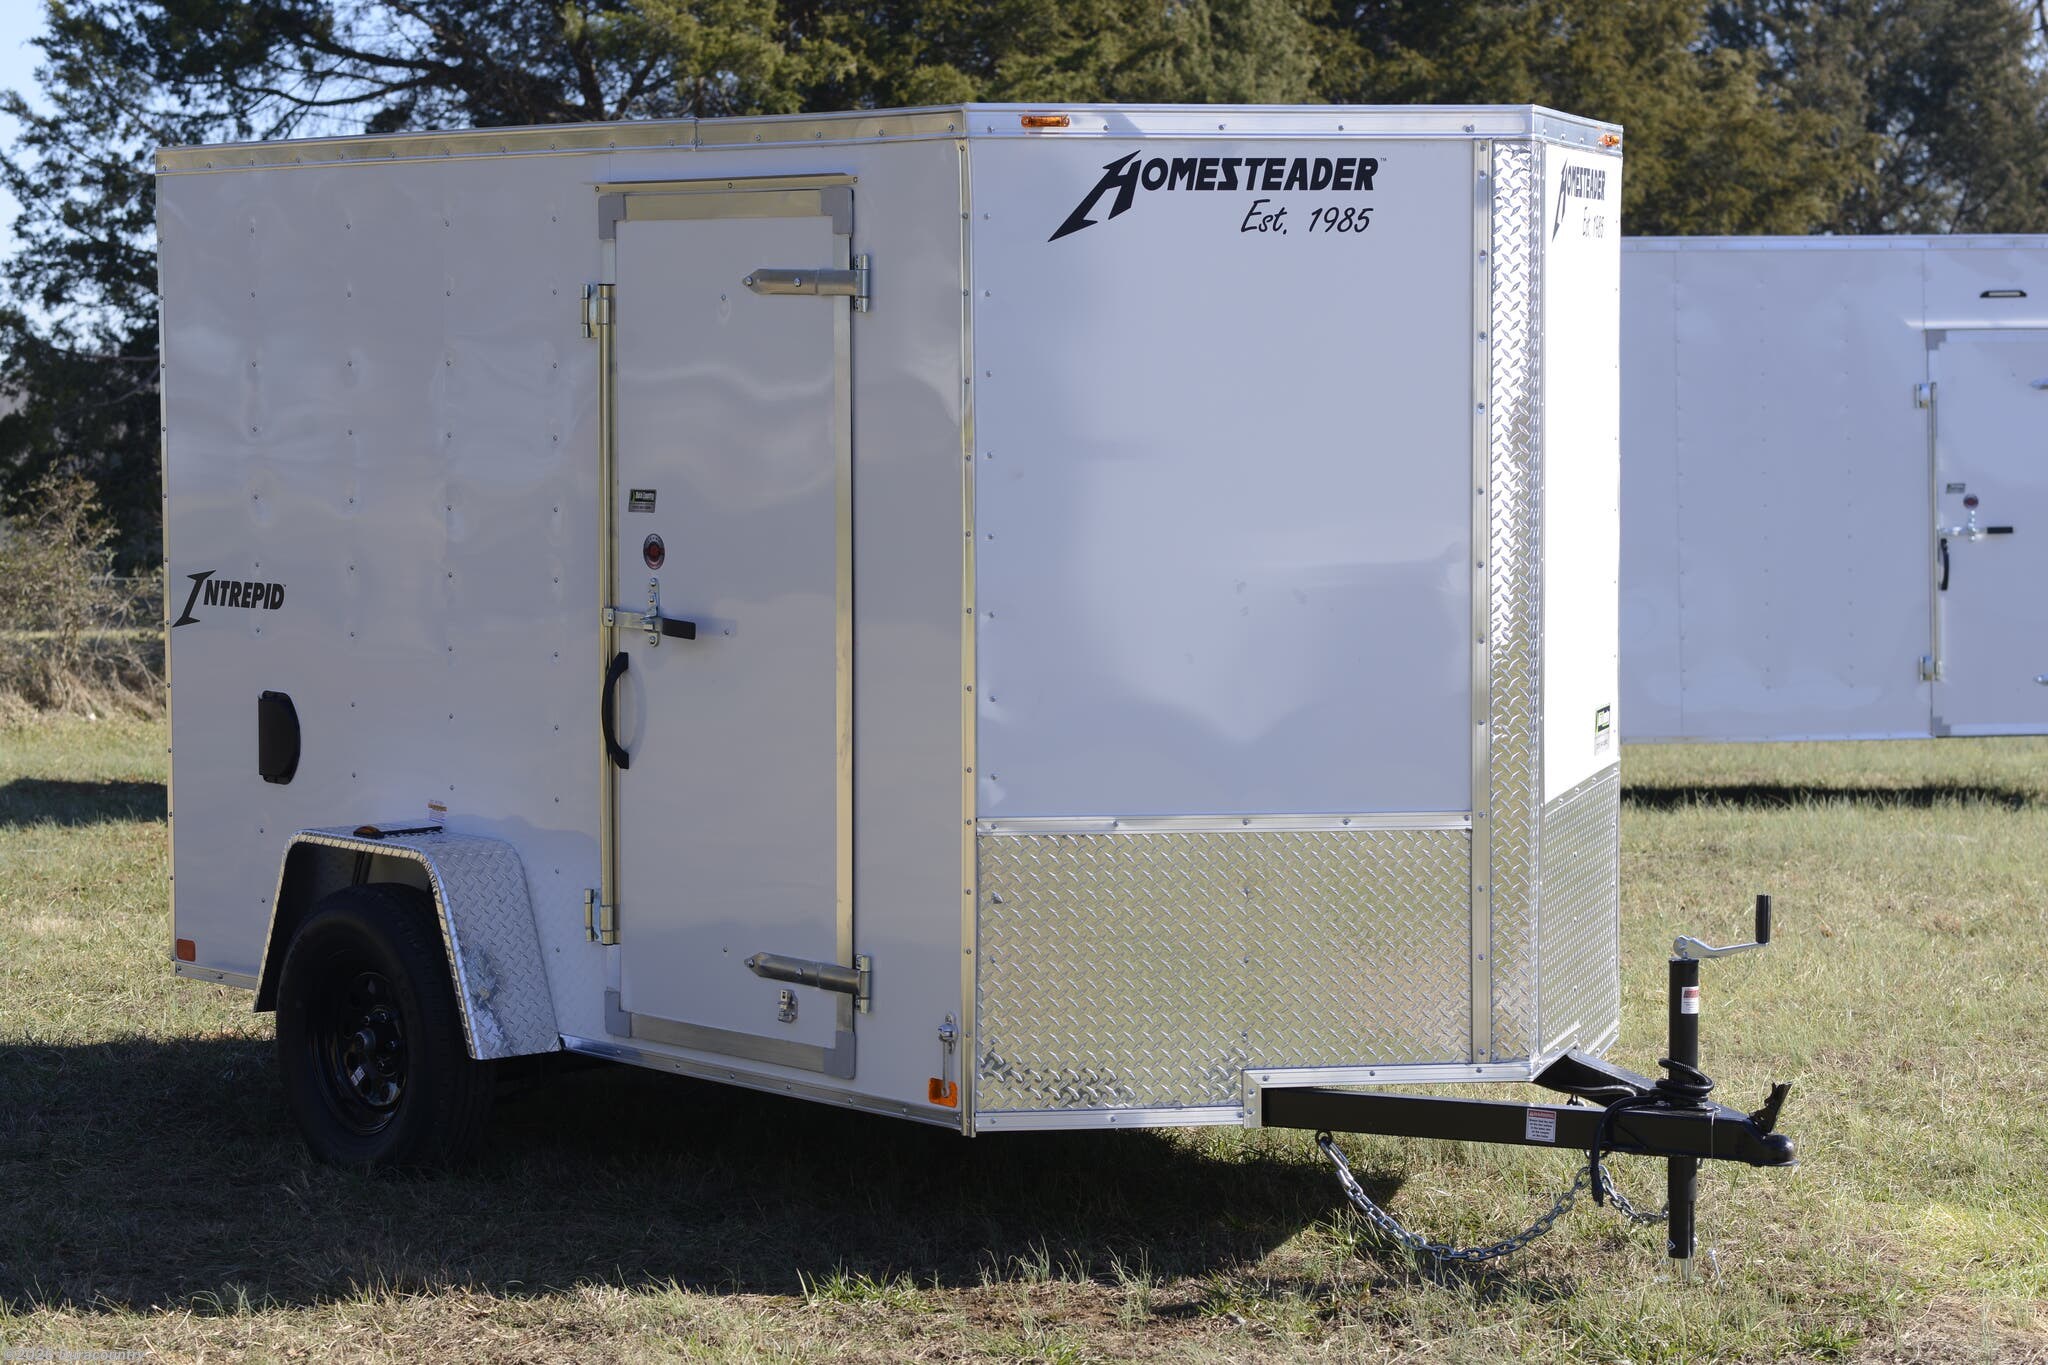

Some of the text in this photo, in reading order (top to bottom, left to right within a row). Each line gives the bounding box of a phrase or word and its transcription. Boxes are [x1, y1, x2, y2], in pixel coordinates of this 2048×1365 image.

[1047, 149, 1378, 242] HOMESTEADER
[1240, 198, 1375, 235] Est. 1985
[1551, 156, 1606, 243] HOMESTEADER
[172, 569, 285, 628] INTREPID
